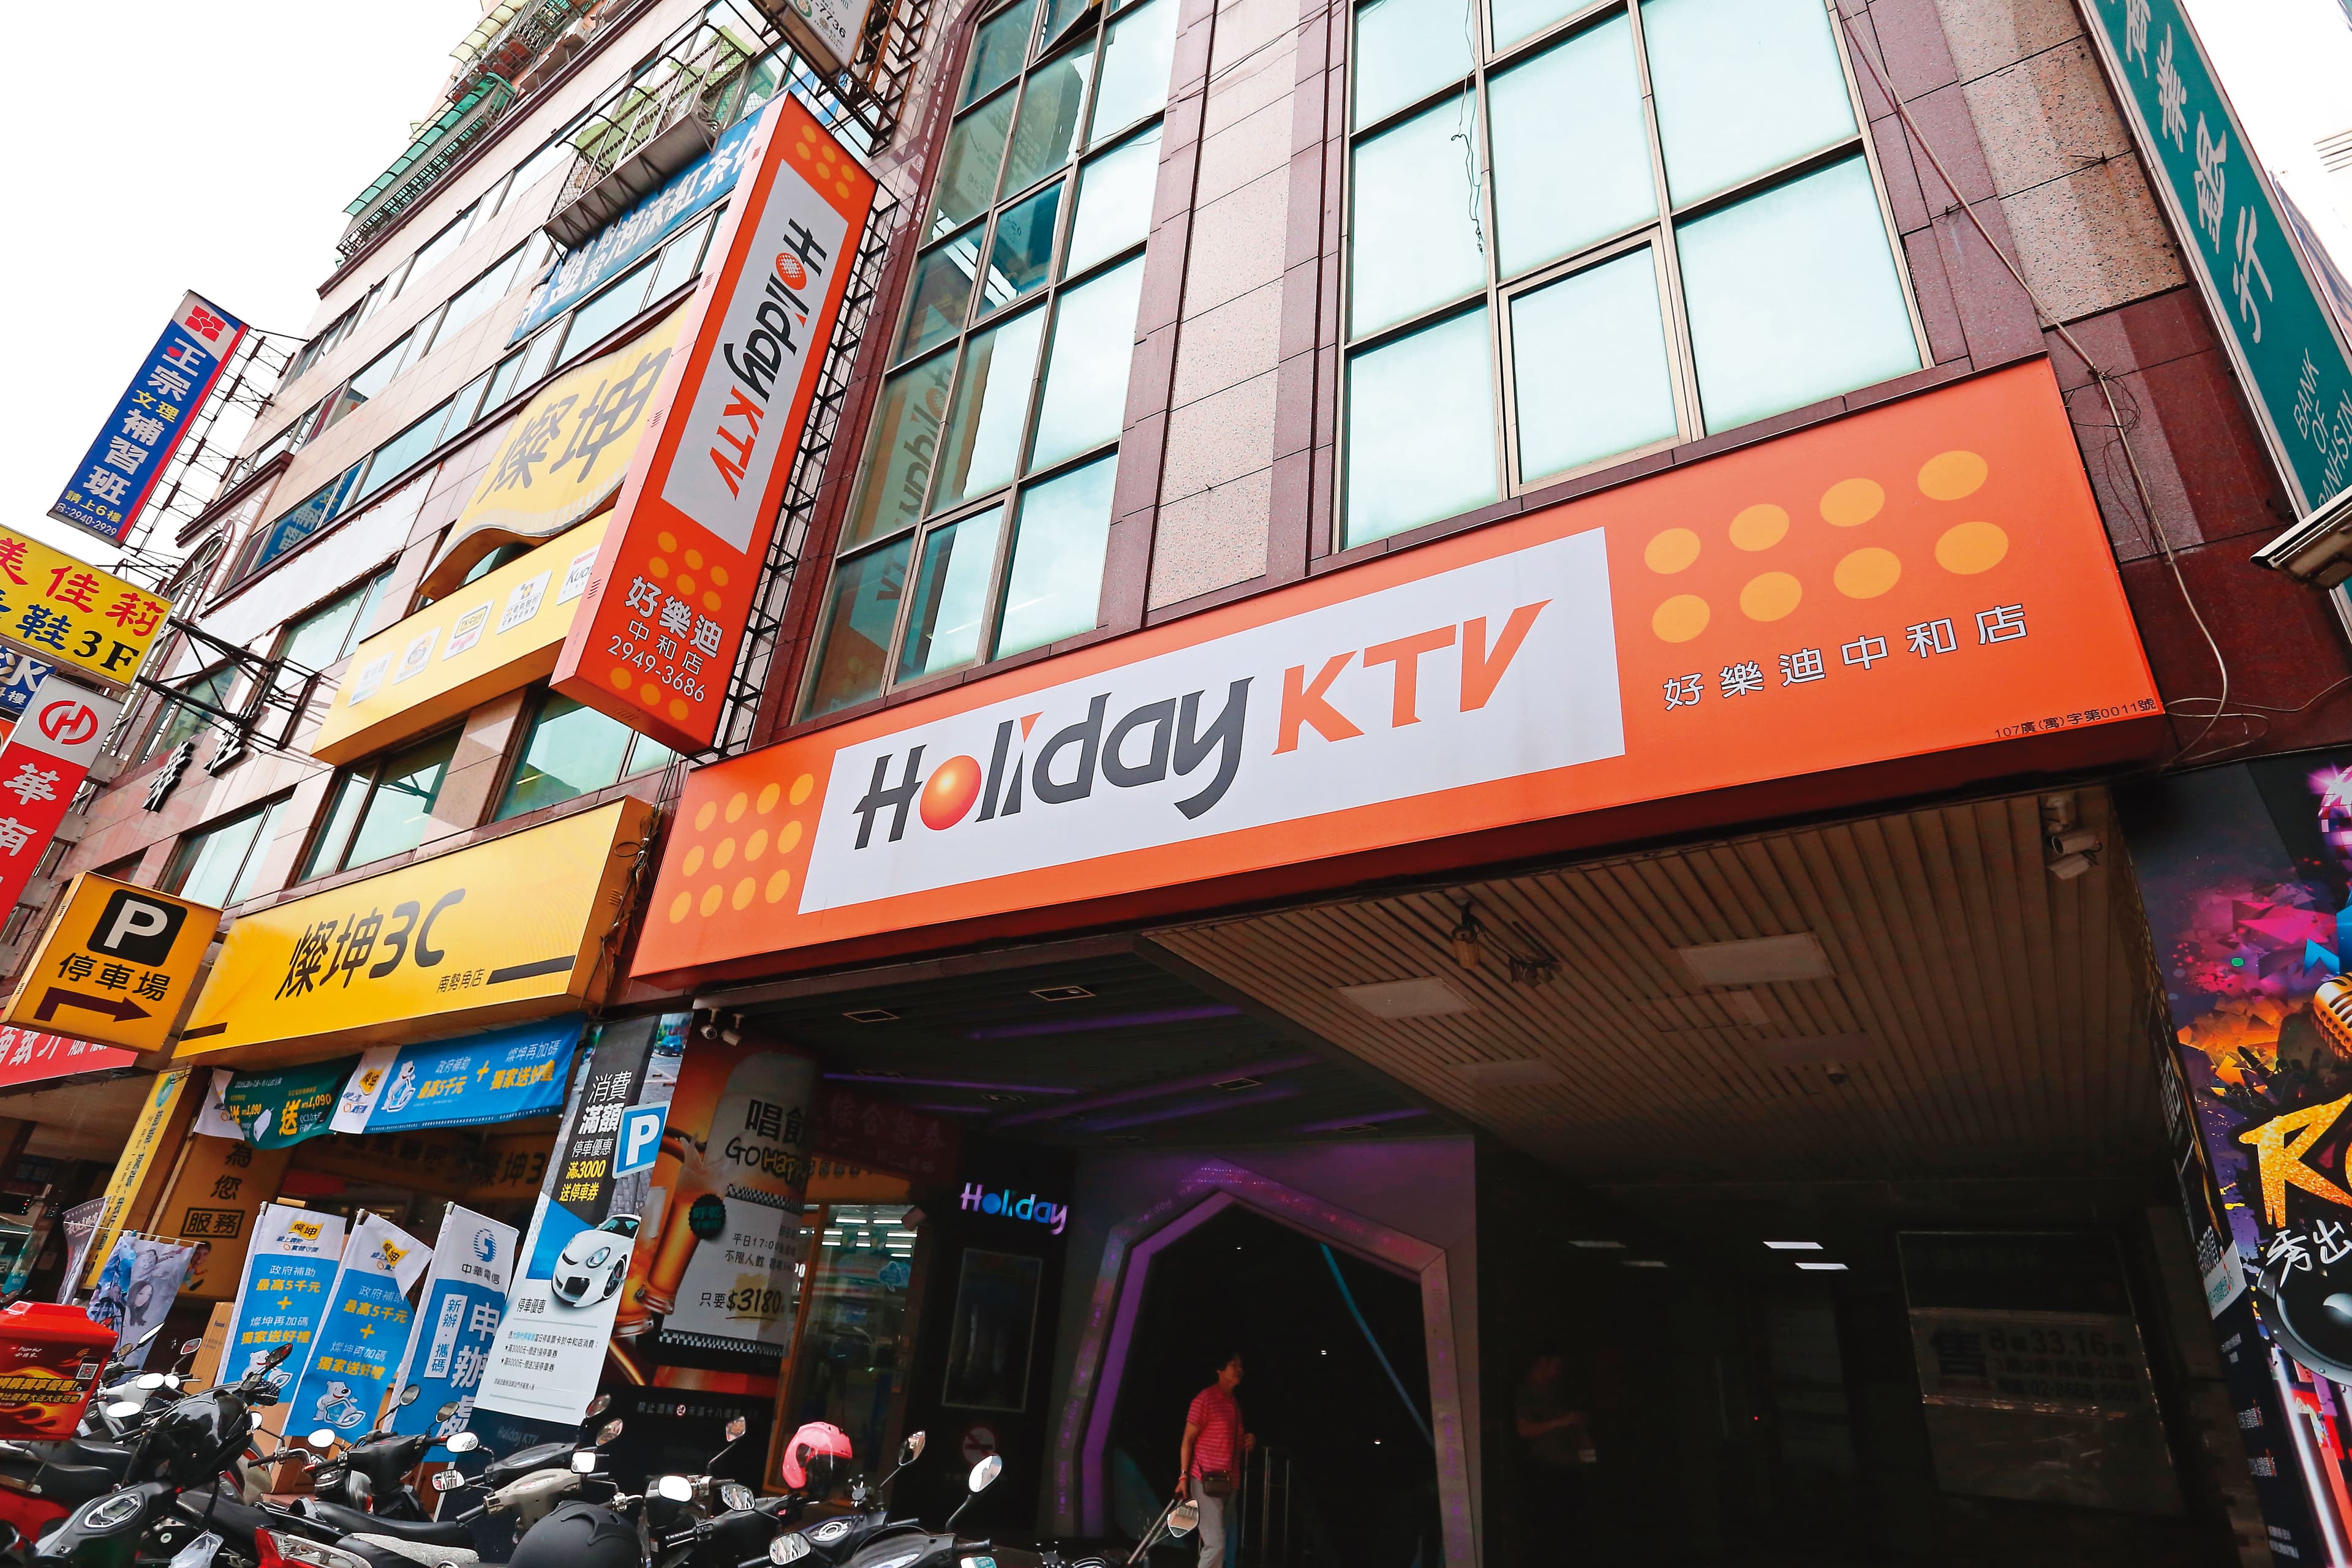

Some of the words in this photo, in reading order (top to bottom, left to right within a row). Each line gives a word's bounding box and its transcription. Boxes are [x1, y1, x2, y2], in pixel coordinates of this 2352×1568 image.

[723, 217, 827, 403] Holiday
[148, 337, 207, 402] 正宗
[132, 390, 180, 423] 文理
[2293, 347, 2320, 441] BANK
[477, 347, 673, 504] 燦坤
[709, 385, 765, 500] KTV
[2312, 399, 2329, 454] OF
[83, 408, 165, 506] 補習班
[64, 490, 123, 524] 請上6樓
[0, 537, 165, 637] 美佳莉
[625, 575, 723, 659] 好樂迪
[627, 620, 704, 676] 中和店
[1662, 602, 2028, 712] 好樂迪中和店
[607, 635, 706, 703] 2949-3686
[852, 676, 1255, 850] Holiday
[1271, 600, 1550, 756] KTV
[104, 899, 168, 949] P
[275, 888, 466, 1001] 燦坤3C
[58, 952, 171, 1002] 停車場
[436, 968, 485, 994] 南勢角店
[505, 1039, 562, 1063] 燦坤再加碼
[587, 1070, 632, 1104] 消費
[278, 1099, 302, 1136] 送
[578, 1102, 625, 1135] 滿額
[572, 1137, 614, 1158] 停車優惠
[625, 1114, 661, 1167] P
[565, 1159, 606, 1180] 滿3000
[559, 1182, 600, 1202] 送停車券
[960, 1182, 1069, 1235] Holiday
[186, 1213, 241, 1235] 服務
[269, 1264, 317, 1277] 政府補助
[2266, 1219, 2352, 1287] 秀出
[255, 1278, 322, 1294] 最高5千元
[461, 1262, 500, 1286] 中華電信
[343, 1298, 409, 1324] 最高5千元
[516, 1298, 547, 1314] 停車優惠
[699, 1292, 726, 1309] 只要
[726, 1289, 782, 1315] $3180
[241, 1330, 312, 1345] 獨家送好禮
[249, 1316, 309, 1328] 燦坤再加碼
[316, 1355, 386, 1381] 獨家送好禮
[330, 1341, 388, 1362] 燦坤再加碼
